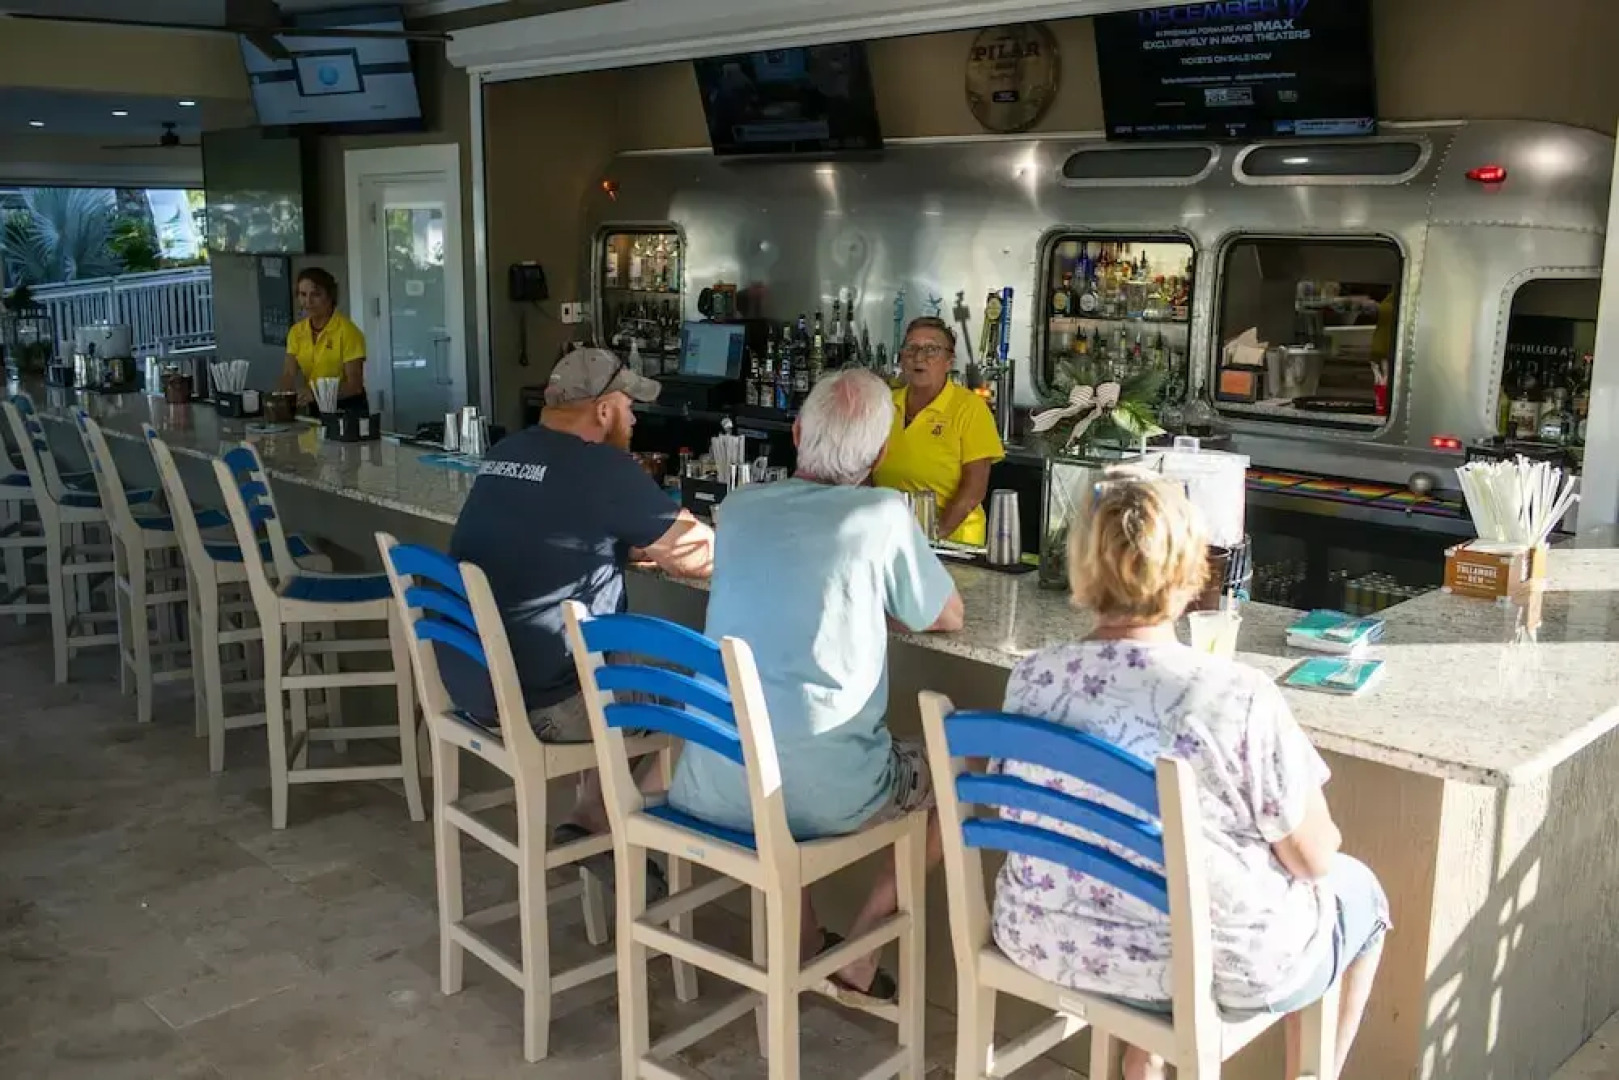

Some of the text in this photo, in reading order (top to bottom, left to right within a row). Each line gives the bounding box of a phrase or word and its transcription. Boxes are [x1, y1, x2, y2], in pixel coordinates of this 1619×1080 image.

[1253, 18, 1295, 32] IMAX
[1142, 28, 1311, 50] EXCLUSIVELY IN MOVIE THEATERS
[971, 42, 1040, 61] PILAR
[1180, 55, 1213, 65] TICKETS
[1228, 53, 1250, 62] SALE
[1251, 52, 1272, 61] NOW
